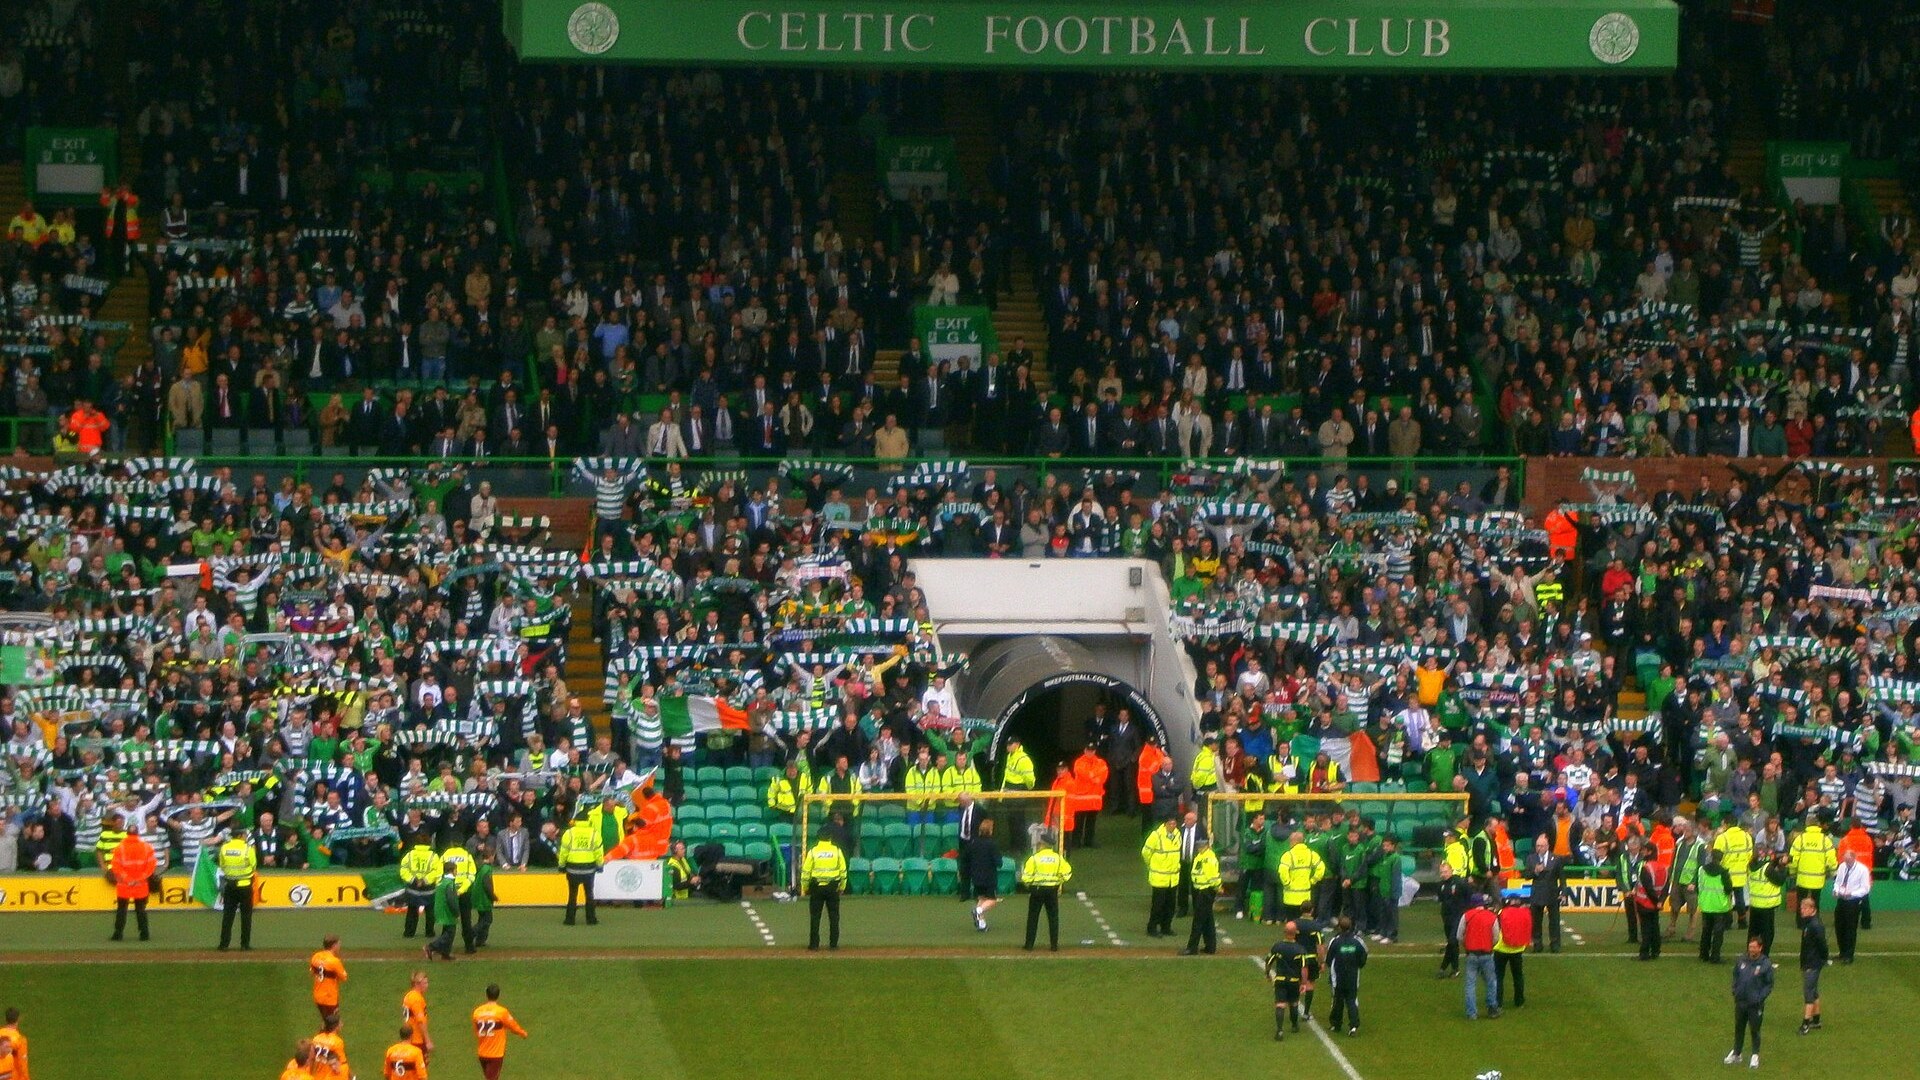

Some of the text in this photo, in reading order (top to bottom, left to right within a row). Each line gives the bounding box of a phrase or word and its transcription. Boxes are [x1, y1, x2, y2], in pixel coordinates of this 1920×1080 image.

[736, 11, 1452, 58] CELTIC FOOTBALL CLUB
[52, 138, 87, 150] EXIT
[900, 145, 933, 157] EXIT
[1781, 153, 1815, 167] EXIT
[935, 317, 971, 330] EXIT
[946, 330, 960, 344] G
[318, 963, 325, 982] 3
[477, 1019, 496, 1037] 22
[395, 1058, 405, 1077] 6
